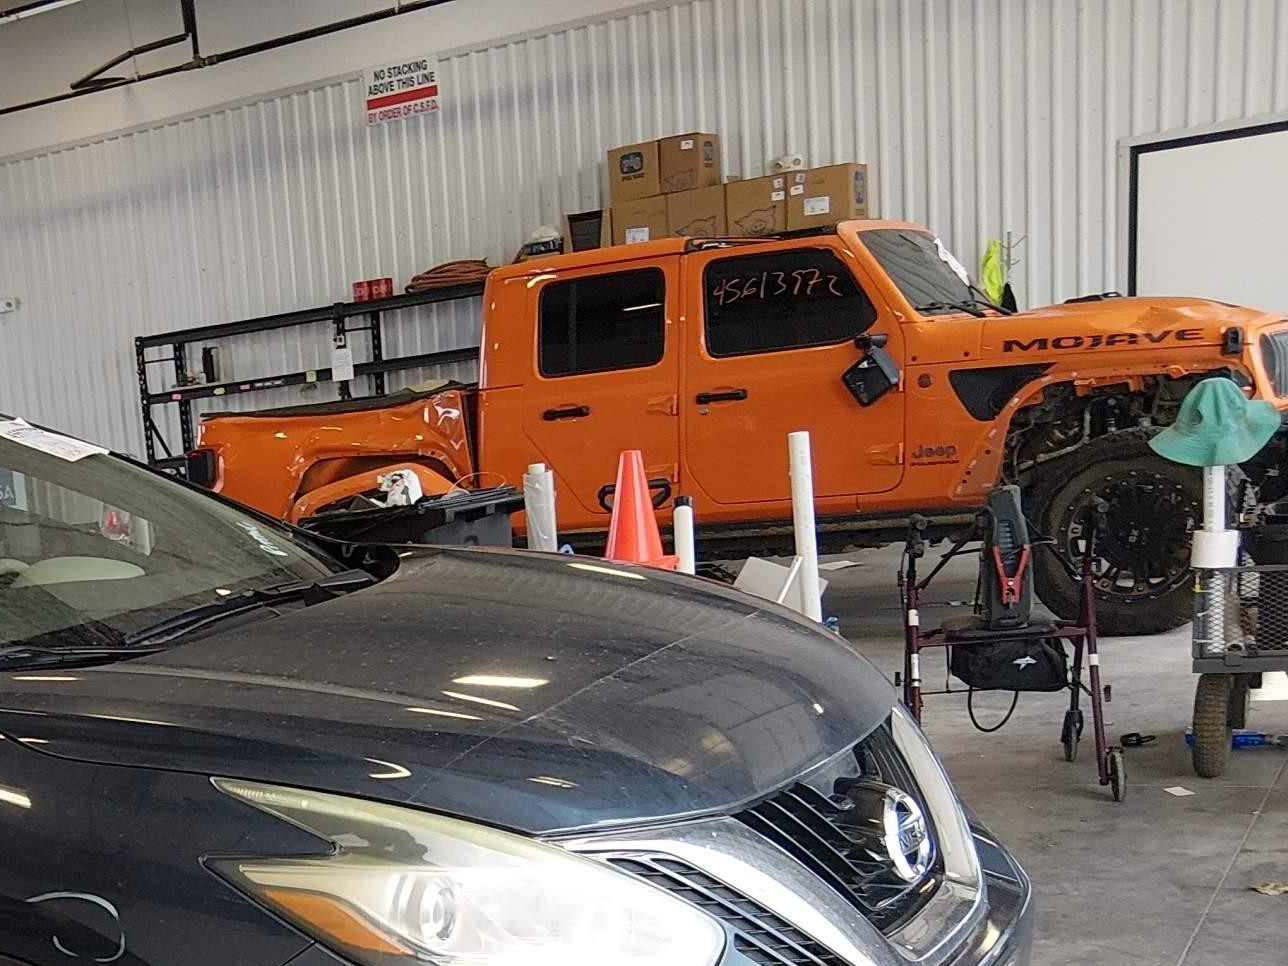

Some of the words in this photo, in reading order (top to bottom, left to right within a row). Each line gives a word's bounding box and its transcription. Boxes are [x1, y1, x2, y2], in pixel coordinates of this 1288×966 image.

[374, 70, 385, 81] NO
[387, 60, 427, 78] STACKING
[368, 81, 394, 96] ABOVE
[397, 76, 415, 89] THIS
[418, 72, 435, 85] LINE
[368, 113, 377, 124] BY
[379, 108, 401, 121] ORDER
[404, 104, 412, 116] OF
[1003, 328, 1204, 352] MOJAVE
[912, 445, 957, 458] Jeep
